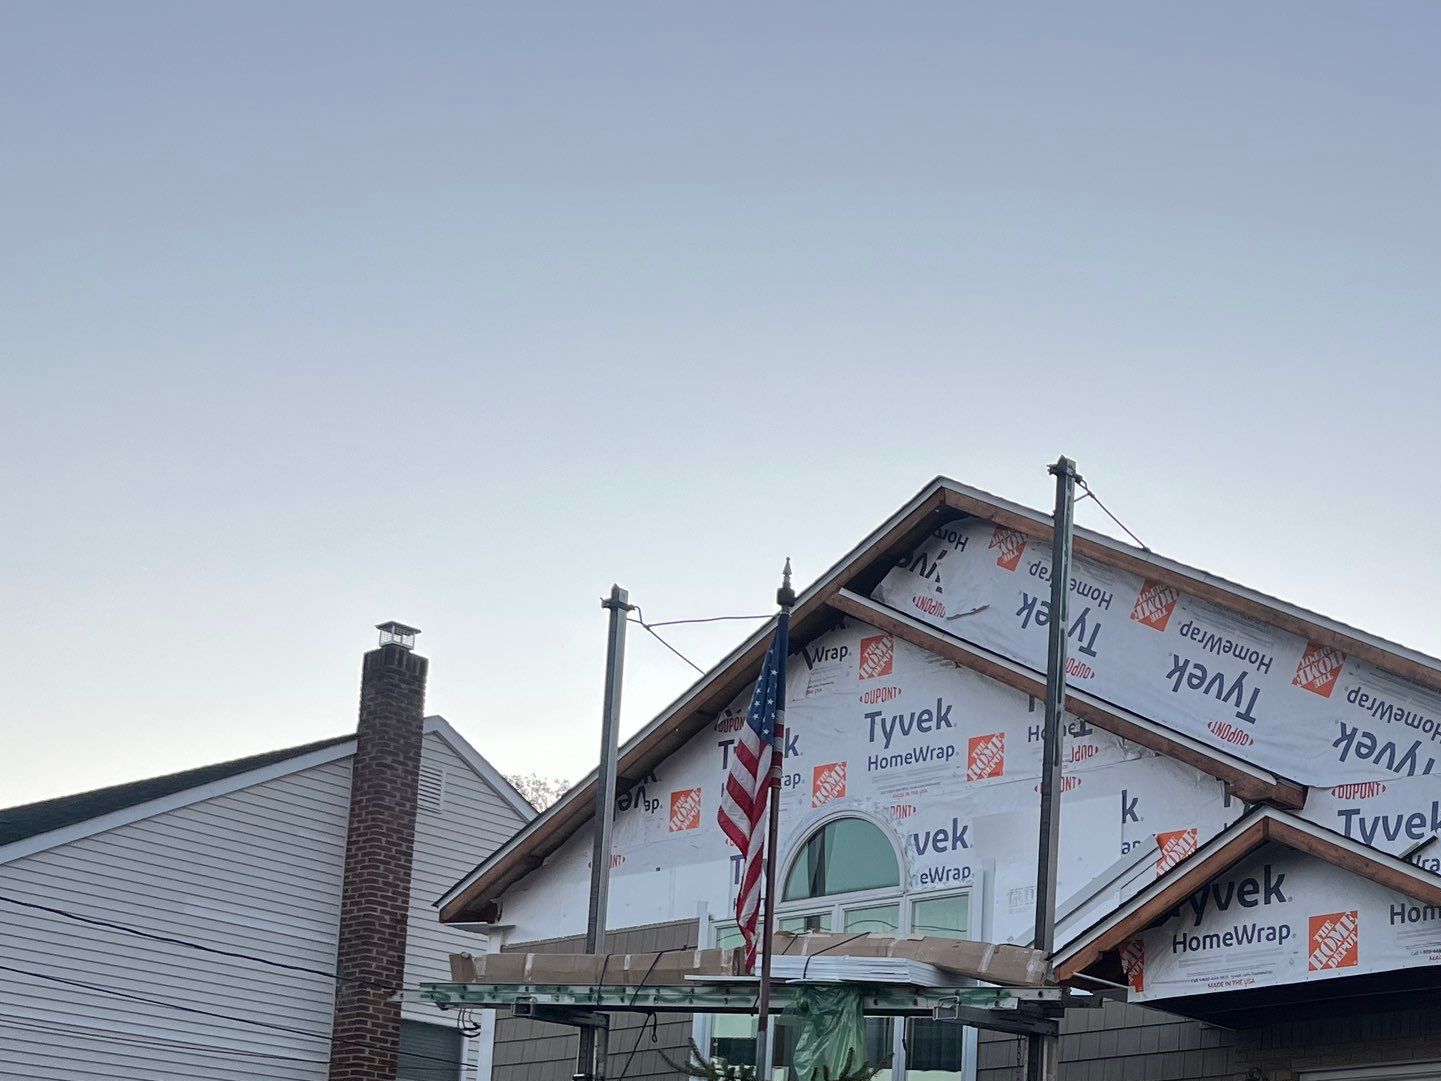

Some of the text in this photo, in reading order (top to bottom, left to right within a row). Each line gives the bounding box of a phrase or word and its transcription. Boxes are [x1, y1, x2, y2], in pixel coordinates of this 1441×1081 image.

[1029, 561, 1113, 610] Homerap
[1016, 592, 1101, 658] Tyek
[813, 645, 848, 662] Wrap
[1180, 620, 1273, 674] HomeWrap
[864, 686, 898, 704] DUPONT
[1166, 653, 1261, 725] Tyvek
[864, 697, 953, 750] Tyvek
[1210, 721, 1249, 746] DUPONT
[867, 744, 955, 772] HomeWrap
[1338, 781, 1381, 800] DUPONT
[890, 804, 912, 819] PONT
[913, 817, 969, 856] vek
[920, 865, 972, 884] eWrap
[1172, 923, 1291, 954] HomeWrap
[1310, 912, 1357, 970] HOME
[1313, 920, 1334, 943] THE
[1328, 931, 1357, 967] DEPOT
